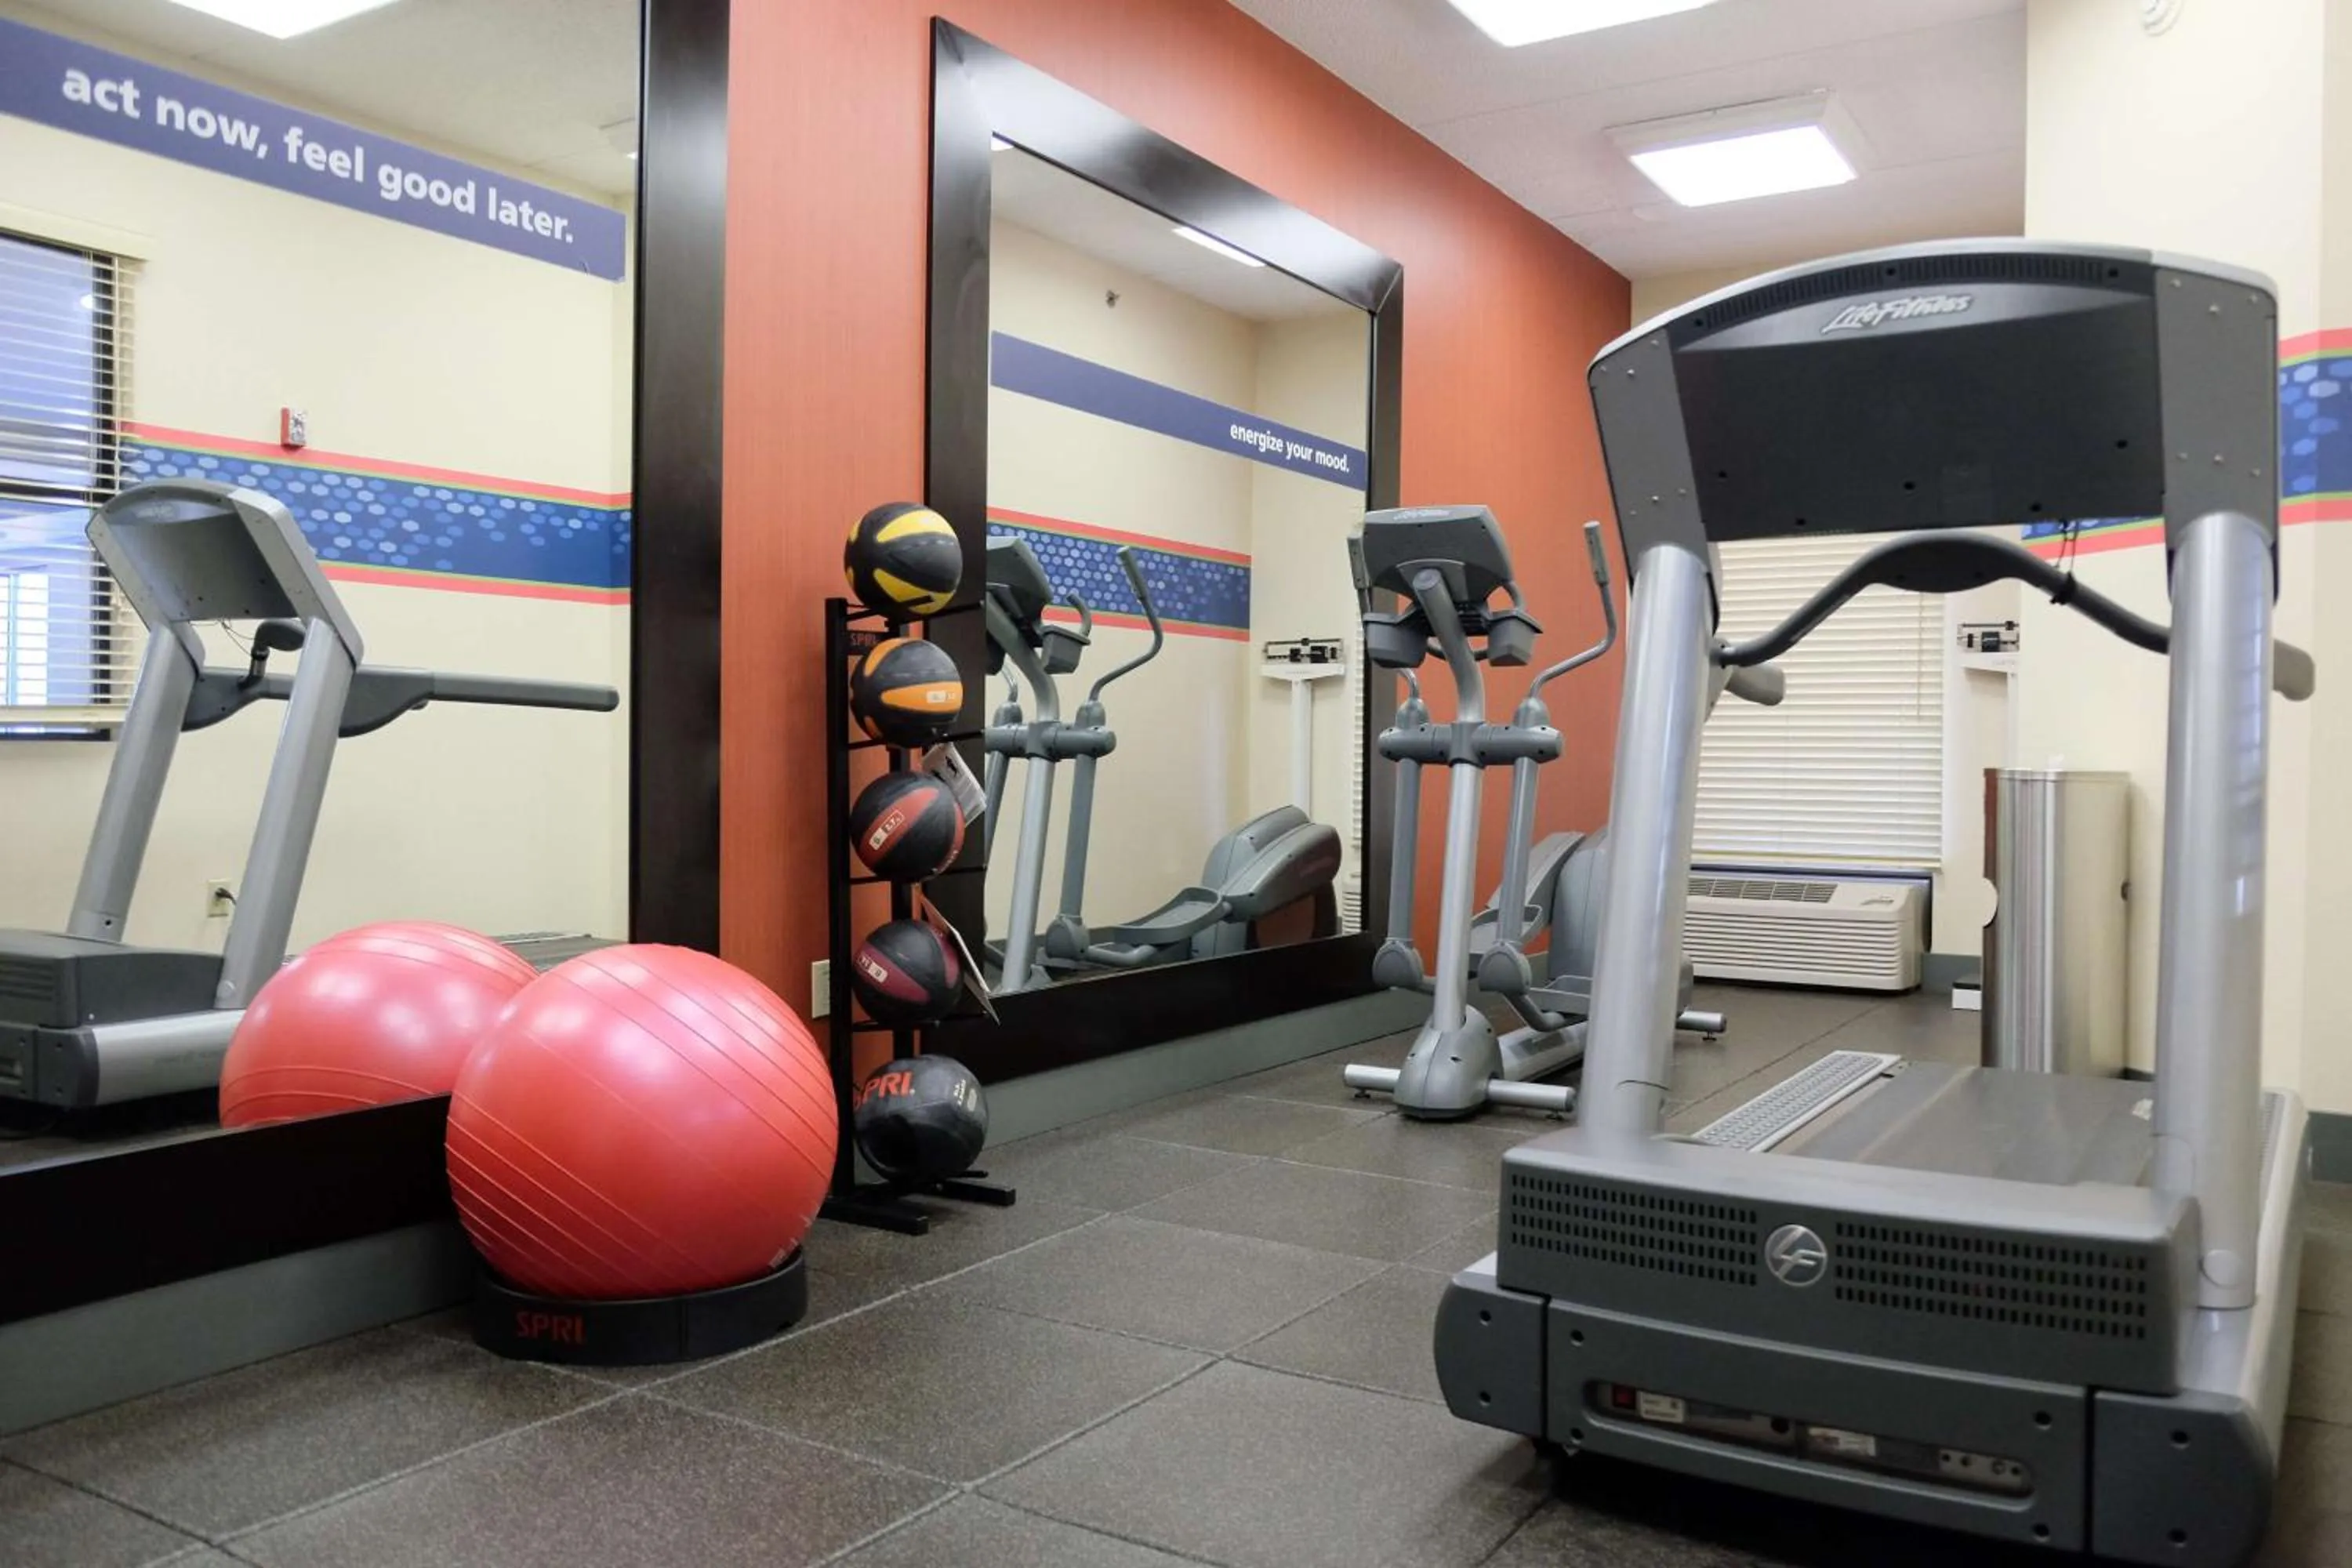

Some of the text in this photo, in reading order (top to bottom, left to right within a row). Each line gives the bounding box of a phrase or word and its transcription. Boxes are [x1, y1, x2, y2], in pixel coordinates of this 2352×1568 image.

[62, 68, 574, 244] act now, feel good later.
[1229, 423, 1350, 474] energize your mood.
[515, 1310, 583, 1345] SPRI
